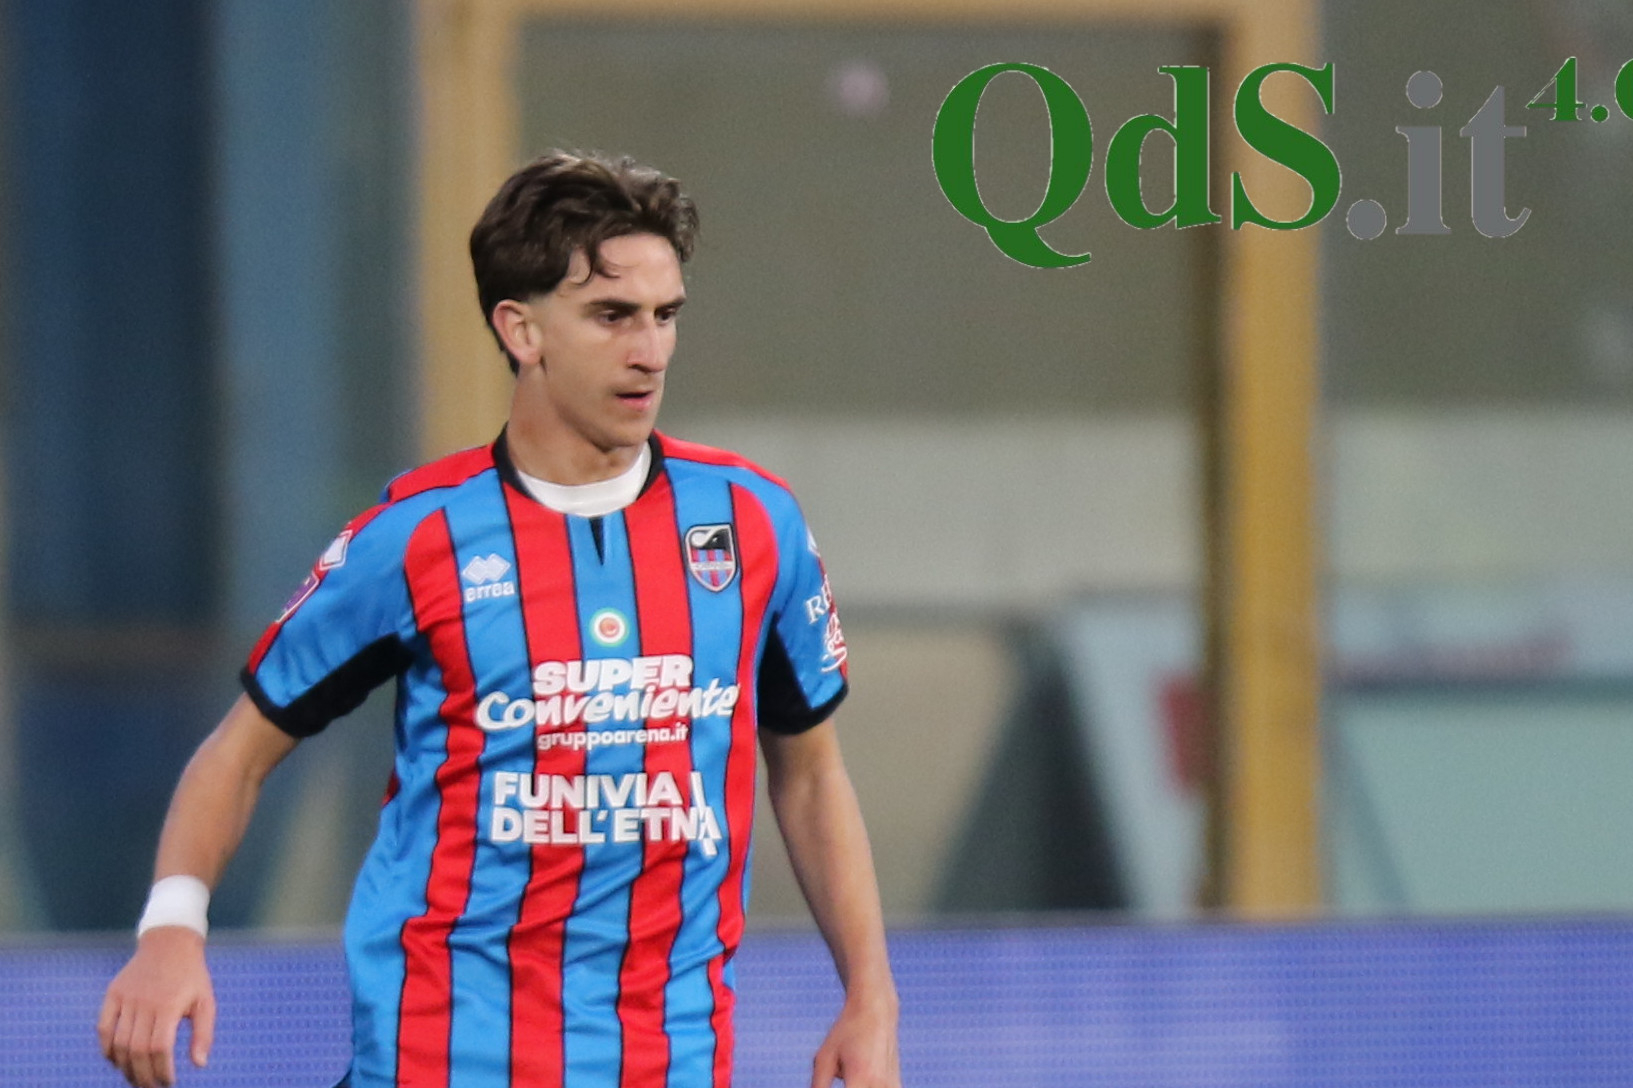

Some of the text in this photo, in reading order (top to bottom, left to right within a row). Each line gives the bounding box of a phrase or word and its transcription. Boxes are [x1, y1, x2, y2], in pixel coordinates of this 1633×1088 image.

[532, 653, 694, 696] SUPER
[474, 678, 740, 731] Conveniente
[537, 721, 689, 750] gruppoarena.it
[494, 771, 684, 809] FUNIVIA
